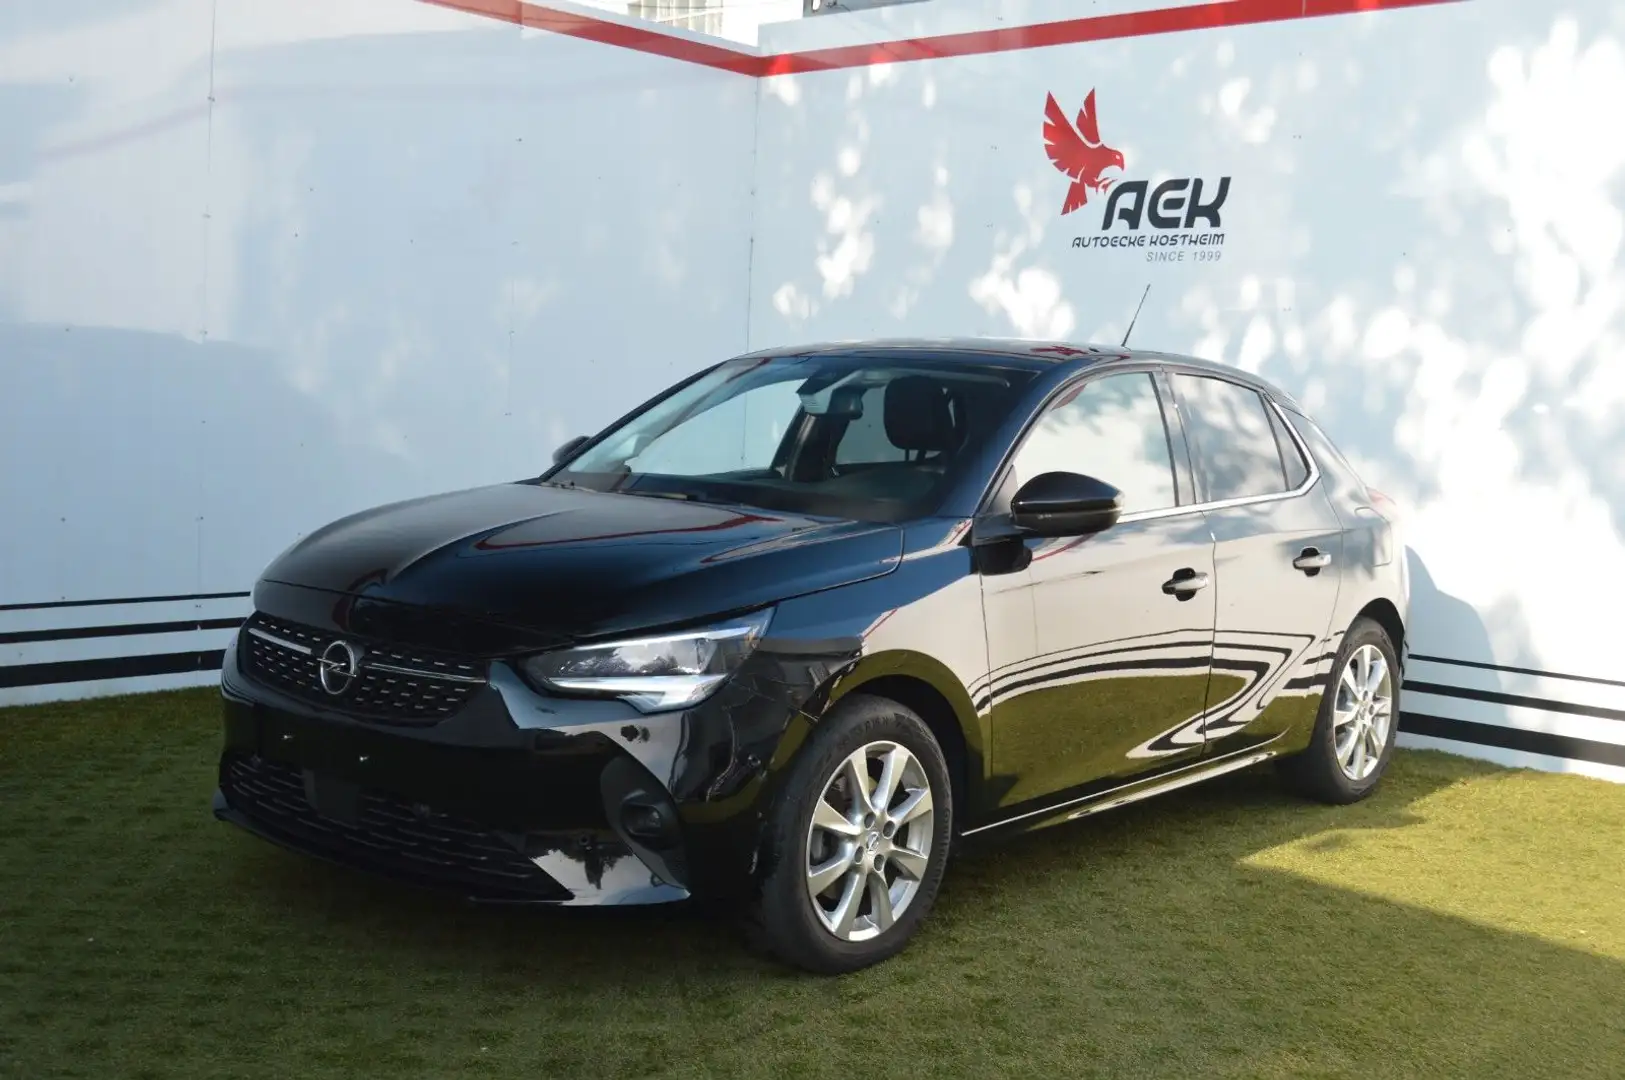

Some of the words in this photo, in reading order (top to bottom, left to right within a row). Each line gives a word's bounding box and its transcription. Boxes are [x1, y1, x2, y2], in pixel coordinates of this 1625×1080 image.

[1102, 177, 1231, 230] AEK
[1072, 236, 1146, 248] AUTOECKE
[1149, 233, 1225, 247] KOSTHEIM
[1146, 251, 1185, 262] SINCE
[1193, 250, 1222, 262] 1999
